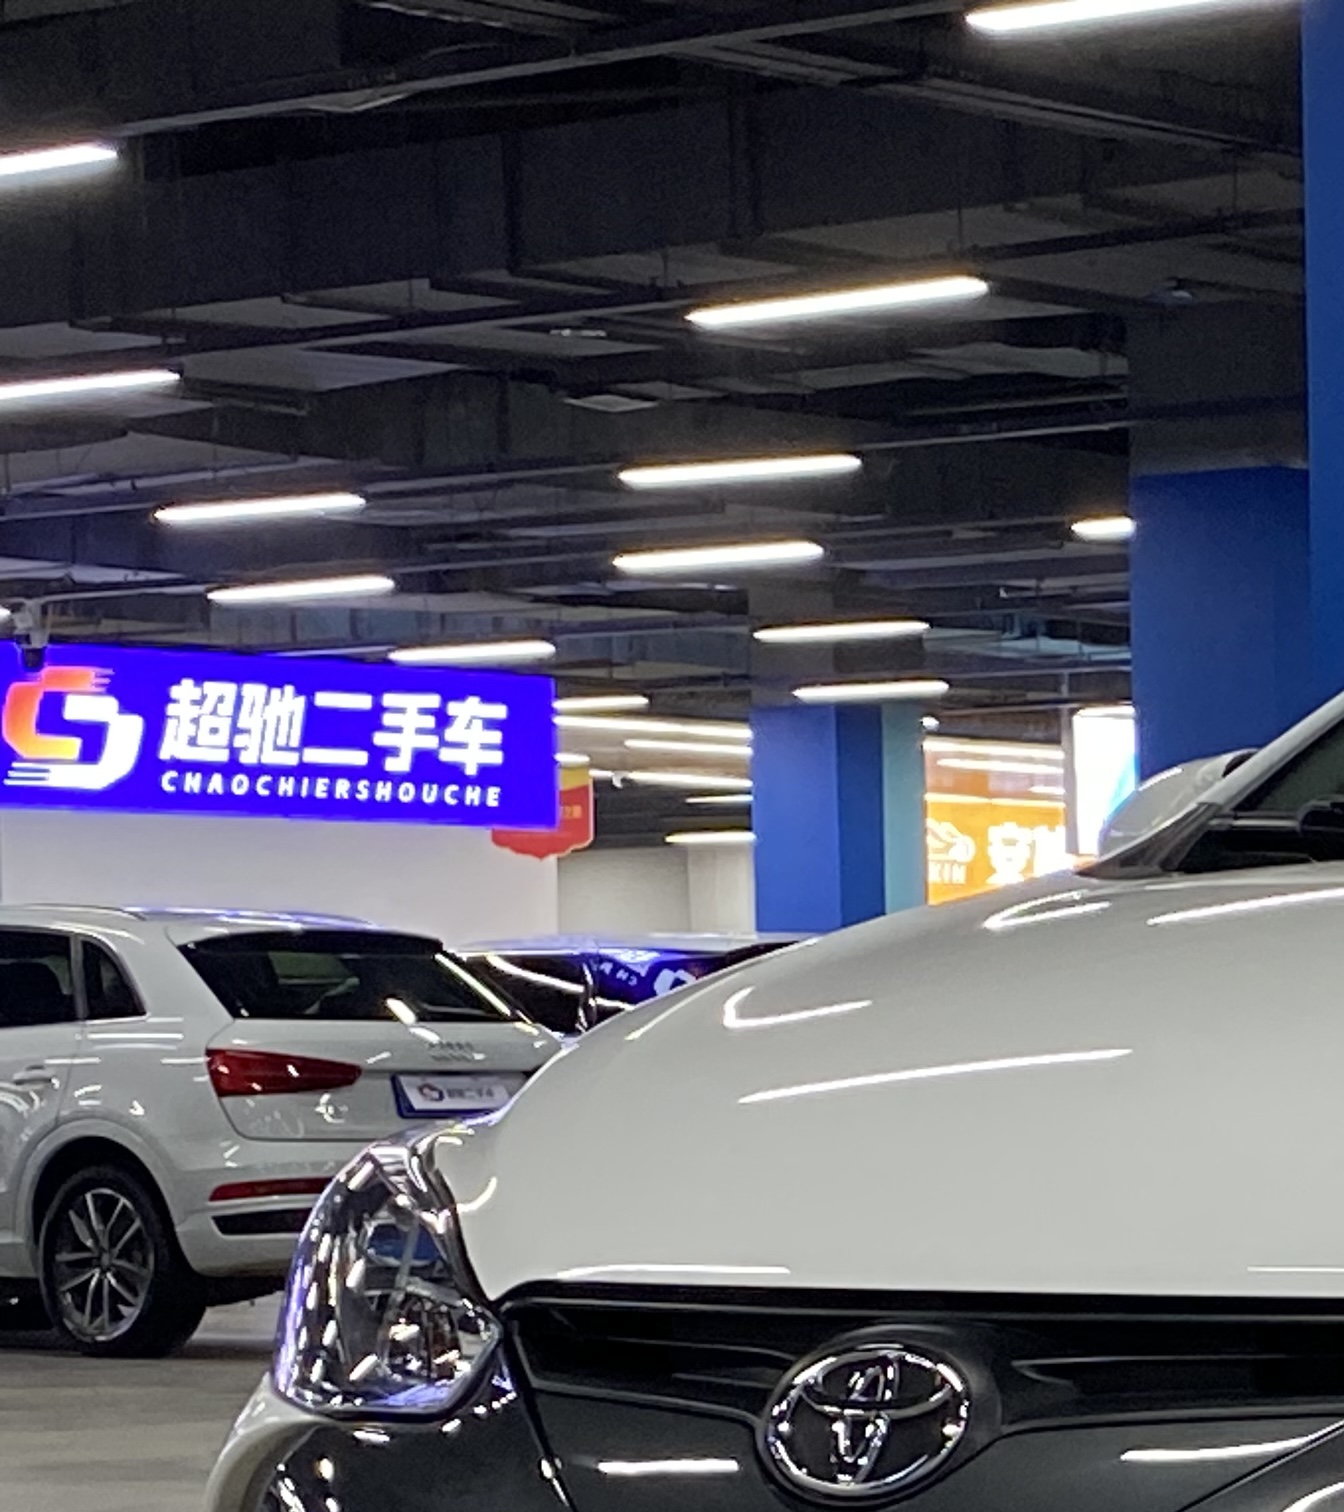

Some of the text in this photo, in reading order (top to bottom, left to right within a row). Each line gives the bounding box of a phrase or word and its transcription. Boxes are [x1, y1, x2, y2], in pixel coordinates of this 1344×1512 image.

[158, 677, 509, 777] 超驰二手车
[160, 769, 502, 808] CHAOCHIERSHOUCHE
